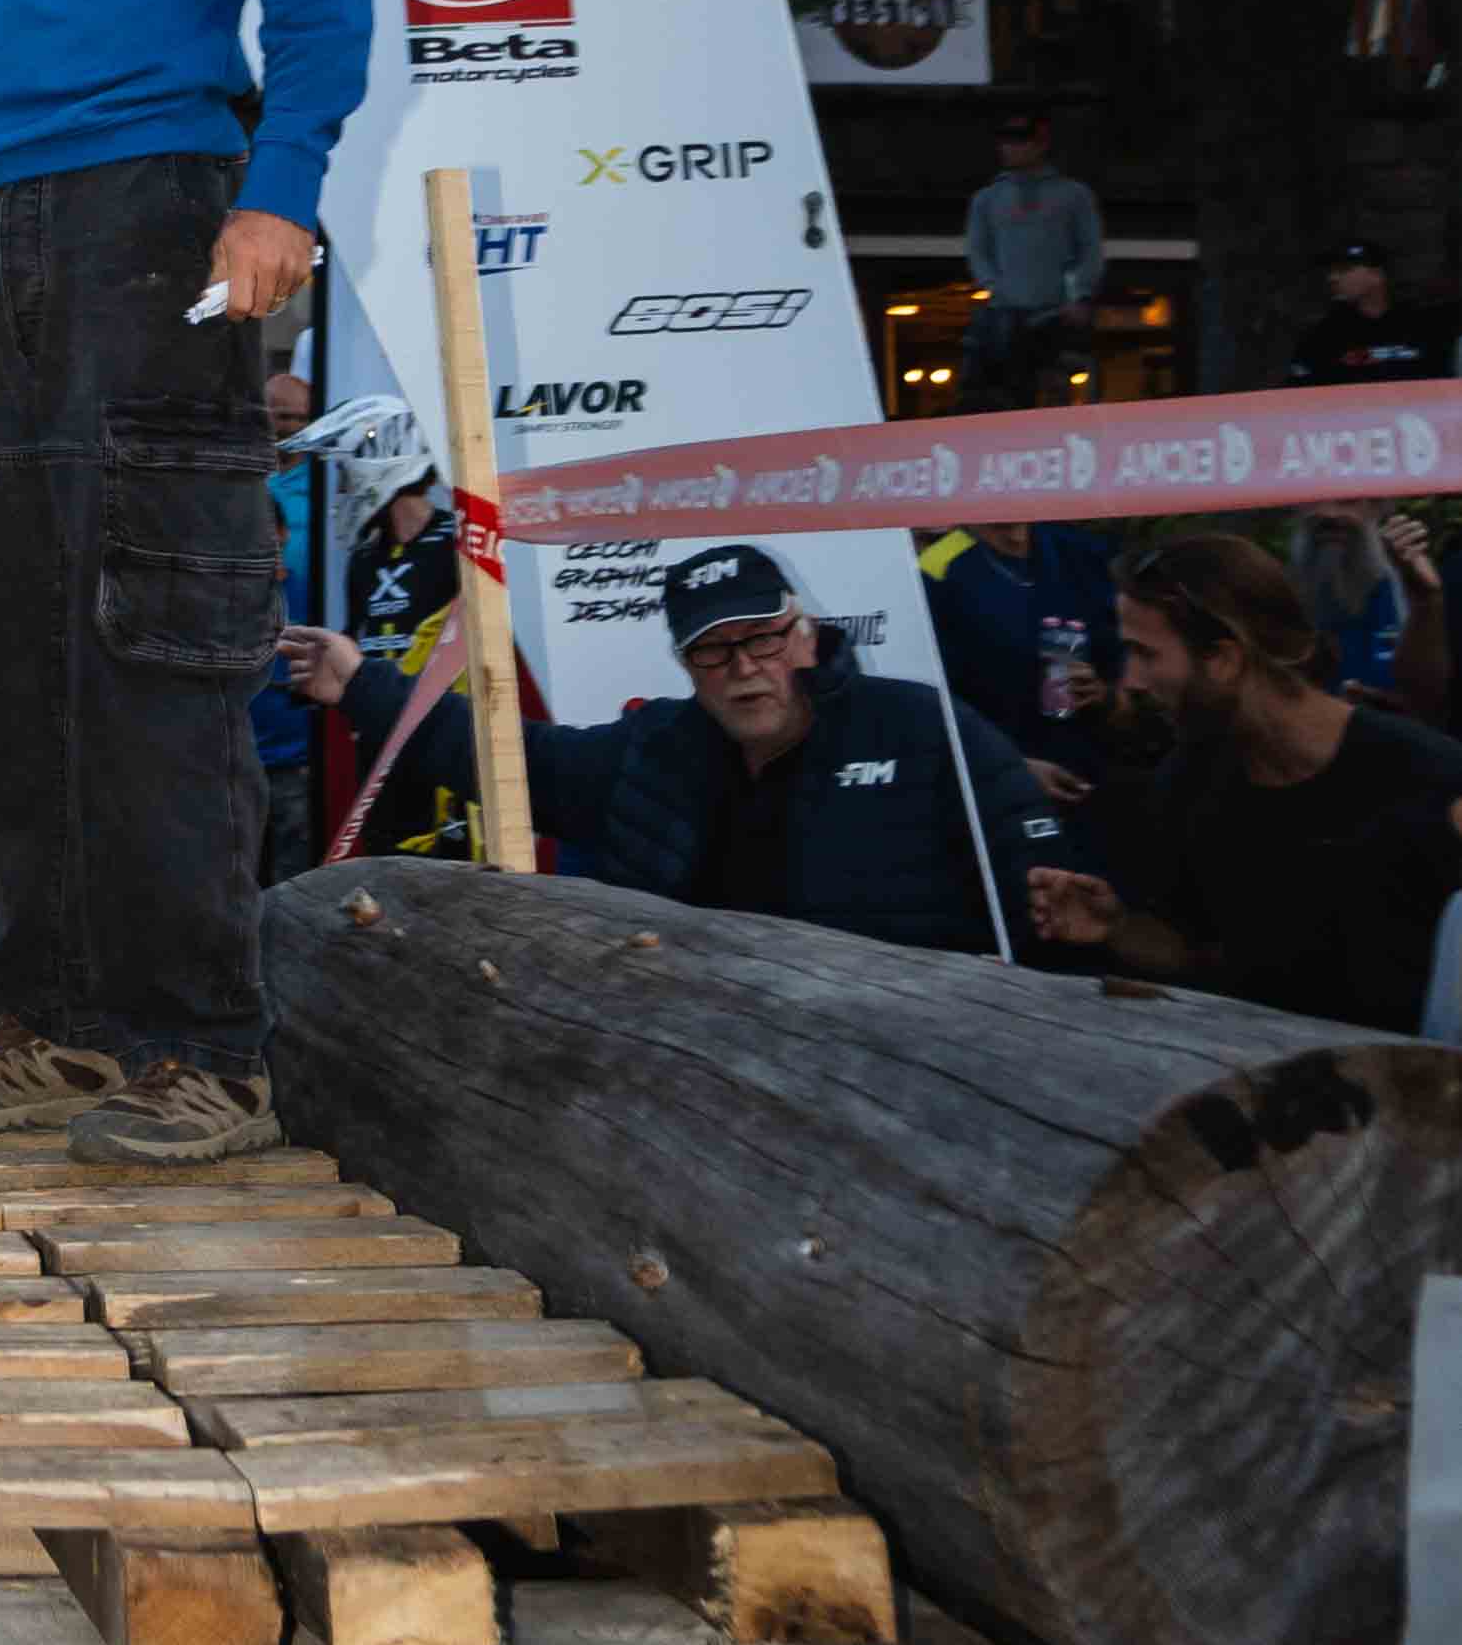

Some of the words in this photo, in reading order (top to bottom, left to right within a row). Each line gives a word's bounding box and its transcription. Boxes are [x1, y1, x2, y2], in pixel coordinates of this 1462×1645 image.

[409, 32, 579, 67] Beta
[411, 62, 579, 86] motorcycles
[493, 379, 648, 418] LAVOR
[554, 566, 667, 590] GRAPHIC
